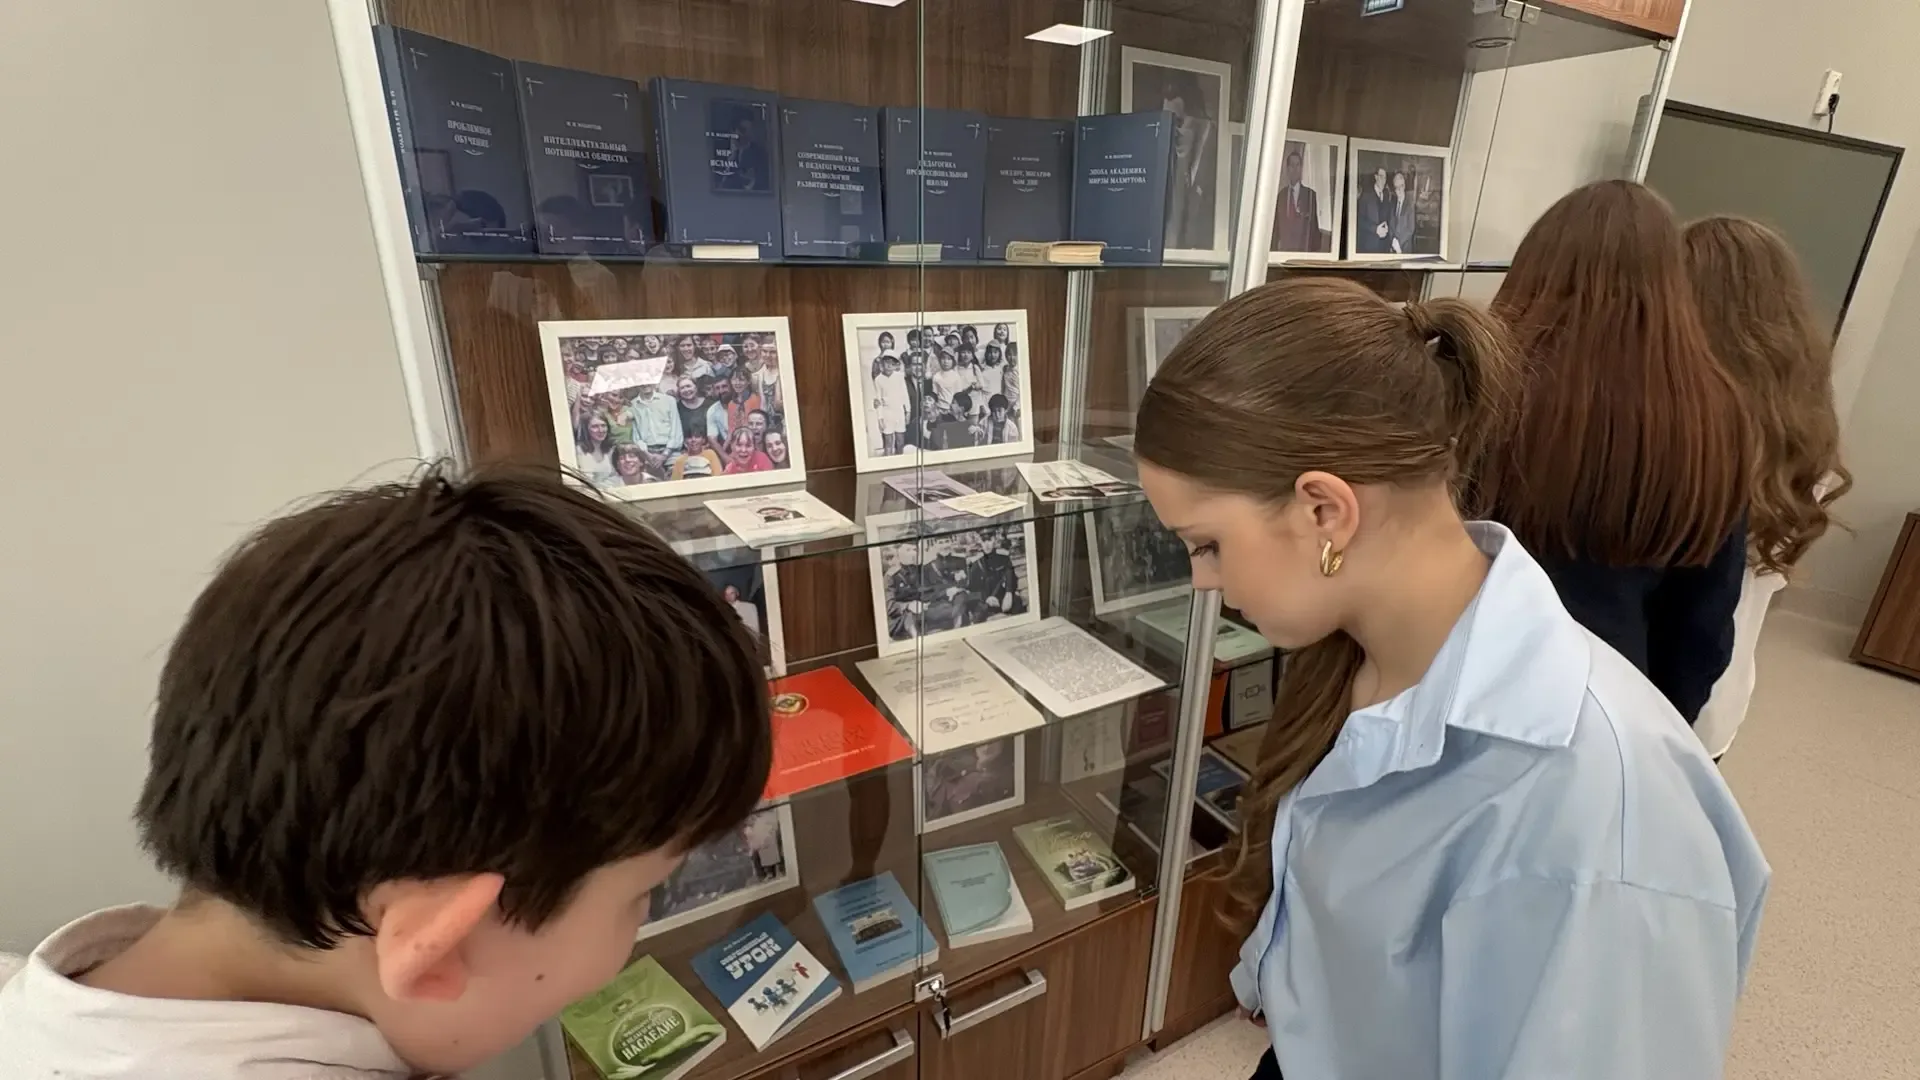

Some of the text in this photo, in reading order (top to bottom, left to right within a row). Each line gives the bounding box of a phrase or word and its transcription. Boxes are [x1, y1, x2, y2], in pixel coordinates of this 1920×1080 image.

[543, 135, 627, 152] ИНТЕЛЛЕКТУАЛЬНЫЙ
[544, 147, 629, 163] ПОТЕНЦИАЛ ОБЩЕСТВА
[1109, 167, 1147, 175] АКАДЕМИКА
[1110, 176, 1146, 184] МАХМУТОВА
[621, 1015, 680, 1061] НАСЛЕДИЕ
